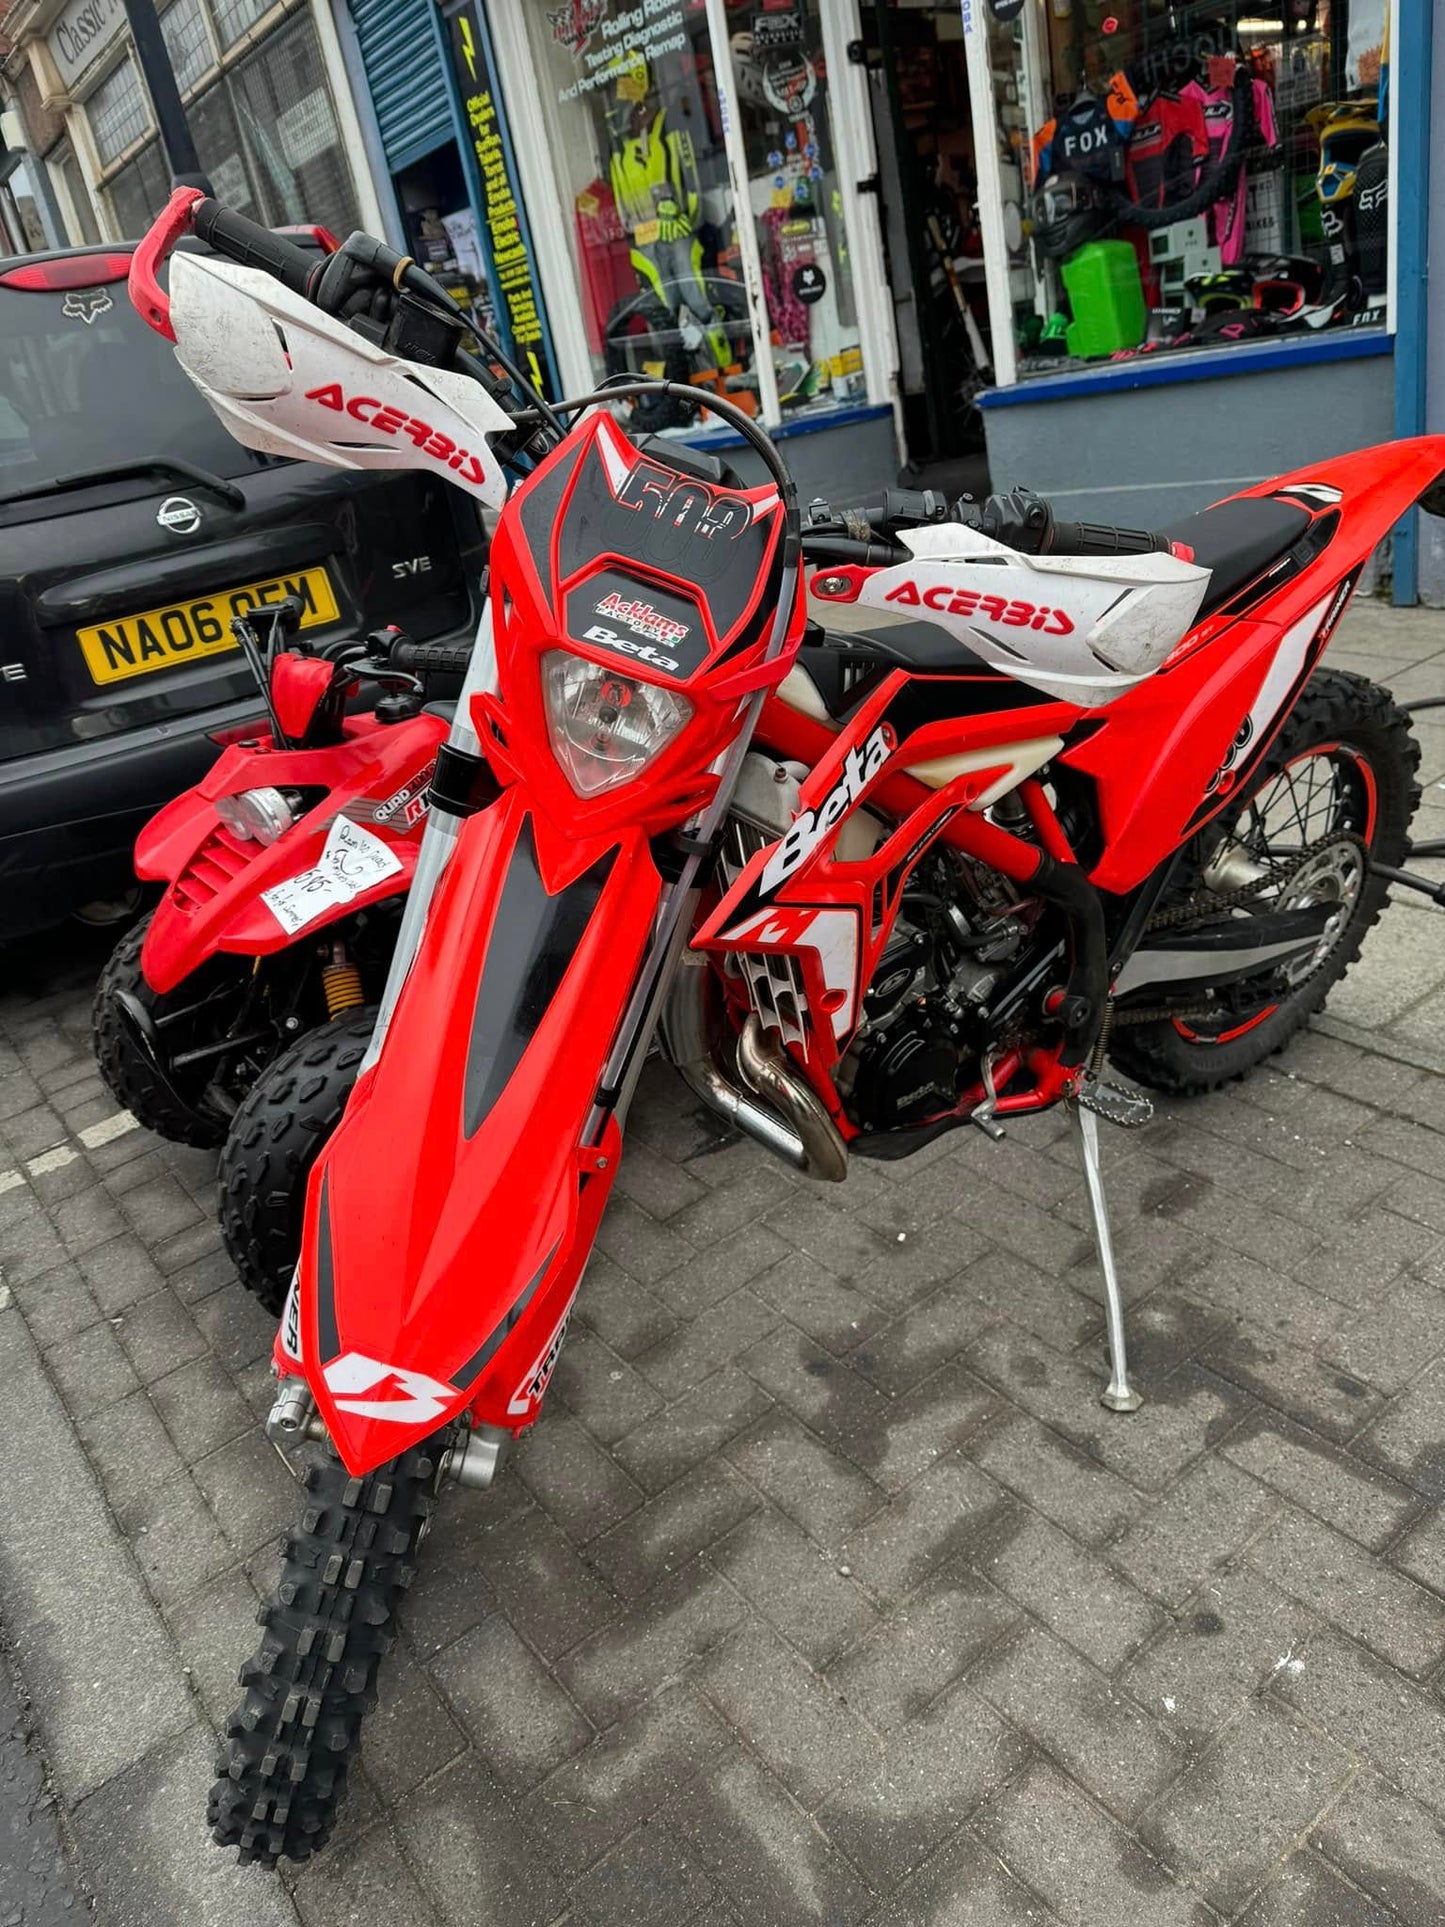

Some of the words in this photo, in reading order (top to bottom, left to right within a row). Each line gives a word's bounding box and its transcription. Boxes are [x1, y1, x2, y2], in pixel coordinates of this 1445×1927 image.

[585, 39, 624, 67] Testing
[623, 11, 683, 49] Diagnostic
[601, 7, 644, 39] Rolling
[558, 82, 578, 103] And
[577, 52, 646, 93] Performance
[644, 32, 686, 60] Remap
[1064, 125, 1108, 157] FOX
[392, 556, 432, 579] SVE
[97, 601, 223, 671] NA06
[596, 606, 660, 634] FACTORY
[583, 625, 680, 671] Beta
[758, 725, 892, 897] Beta
